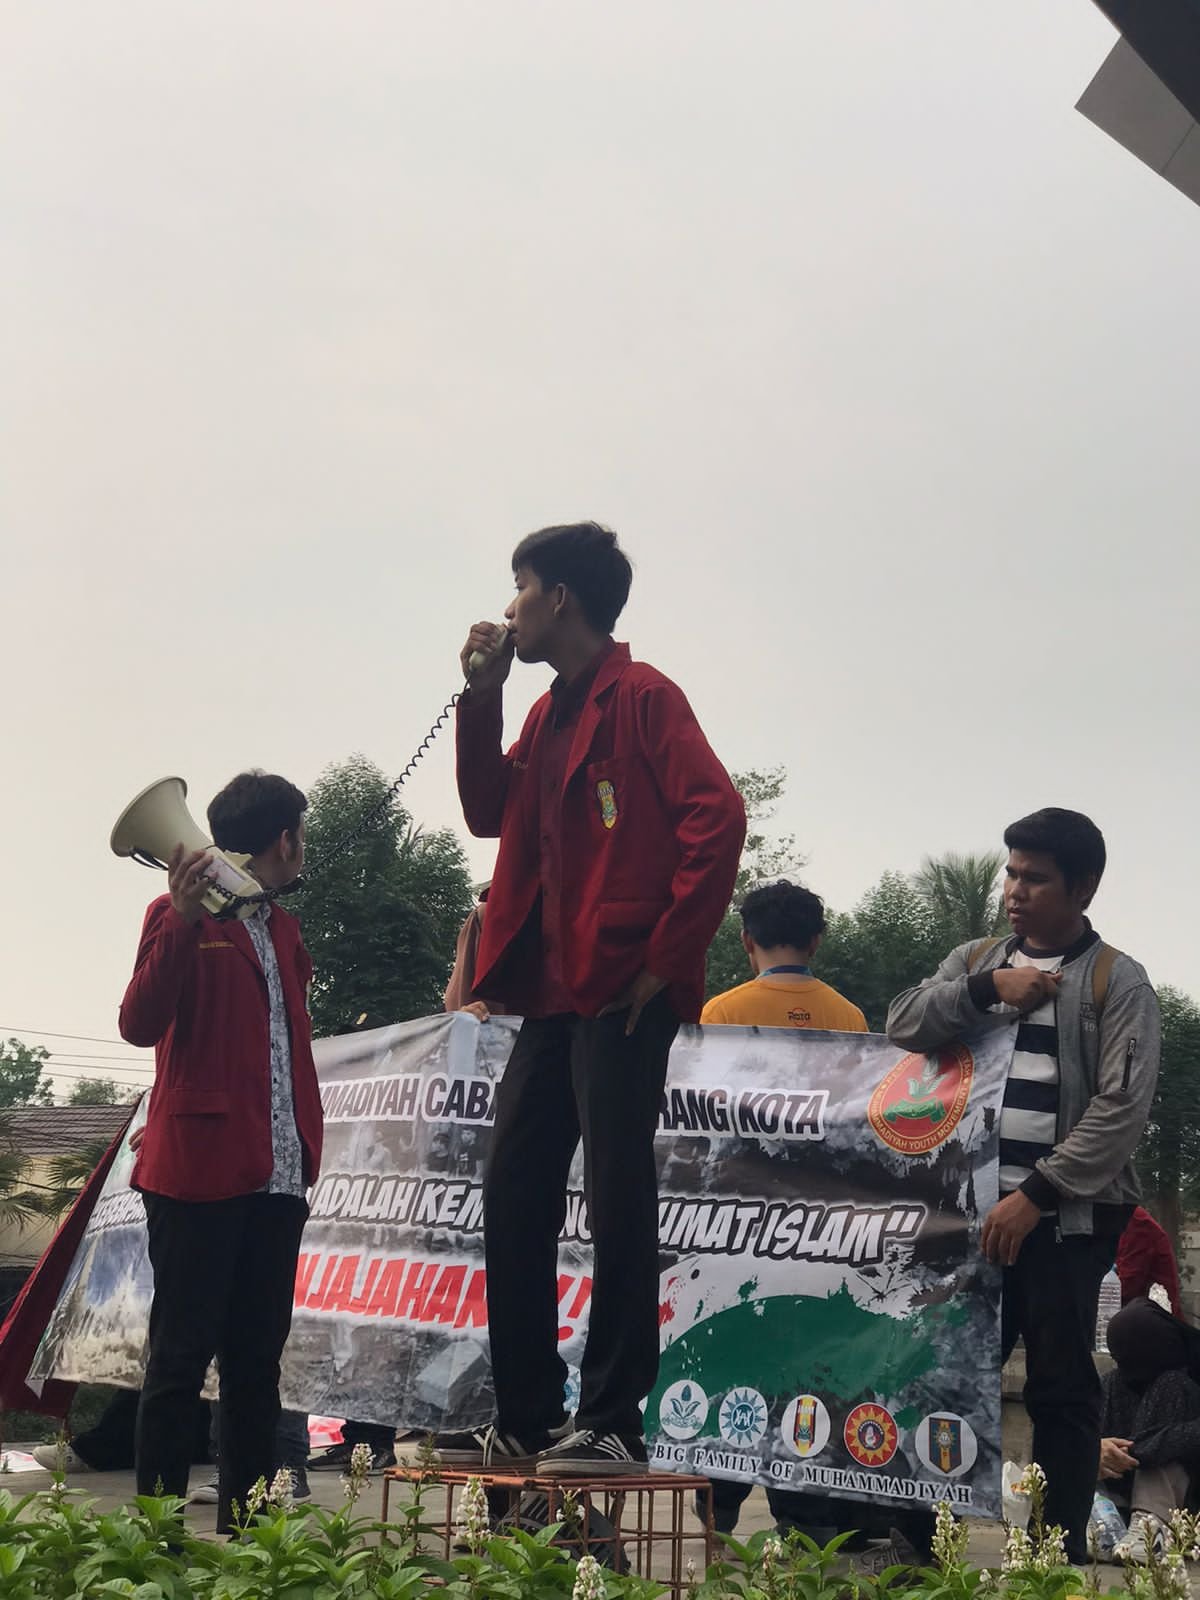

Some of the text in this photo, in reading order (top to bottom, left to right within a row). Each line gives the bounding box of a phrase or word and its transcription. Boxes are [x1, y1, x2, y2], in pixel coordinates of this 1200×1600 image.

[425, 1078, 496, 1121] CAB
[738, 1092, 825, 1134] KOTA
[311, 1178, 417, 1220] ADALAH
[657, 1202, 761, 1250] UMAT
[655, 1444, 971, 1503] BIG FAMILY OF MUHAMMADIYAH
